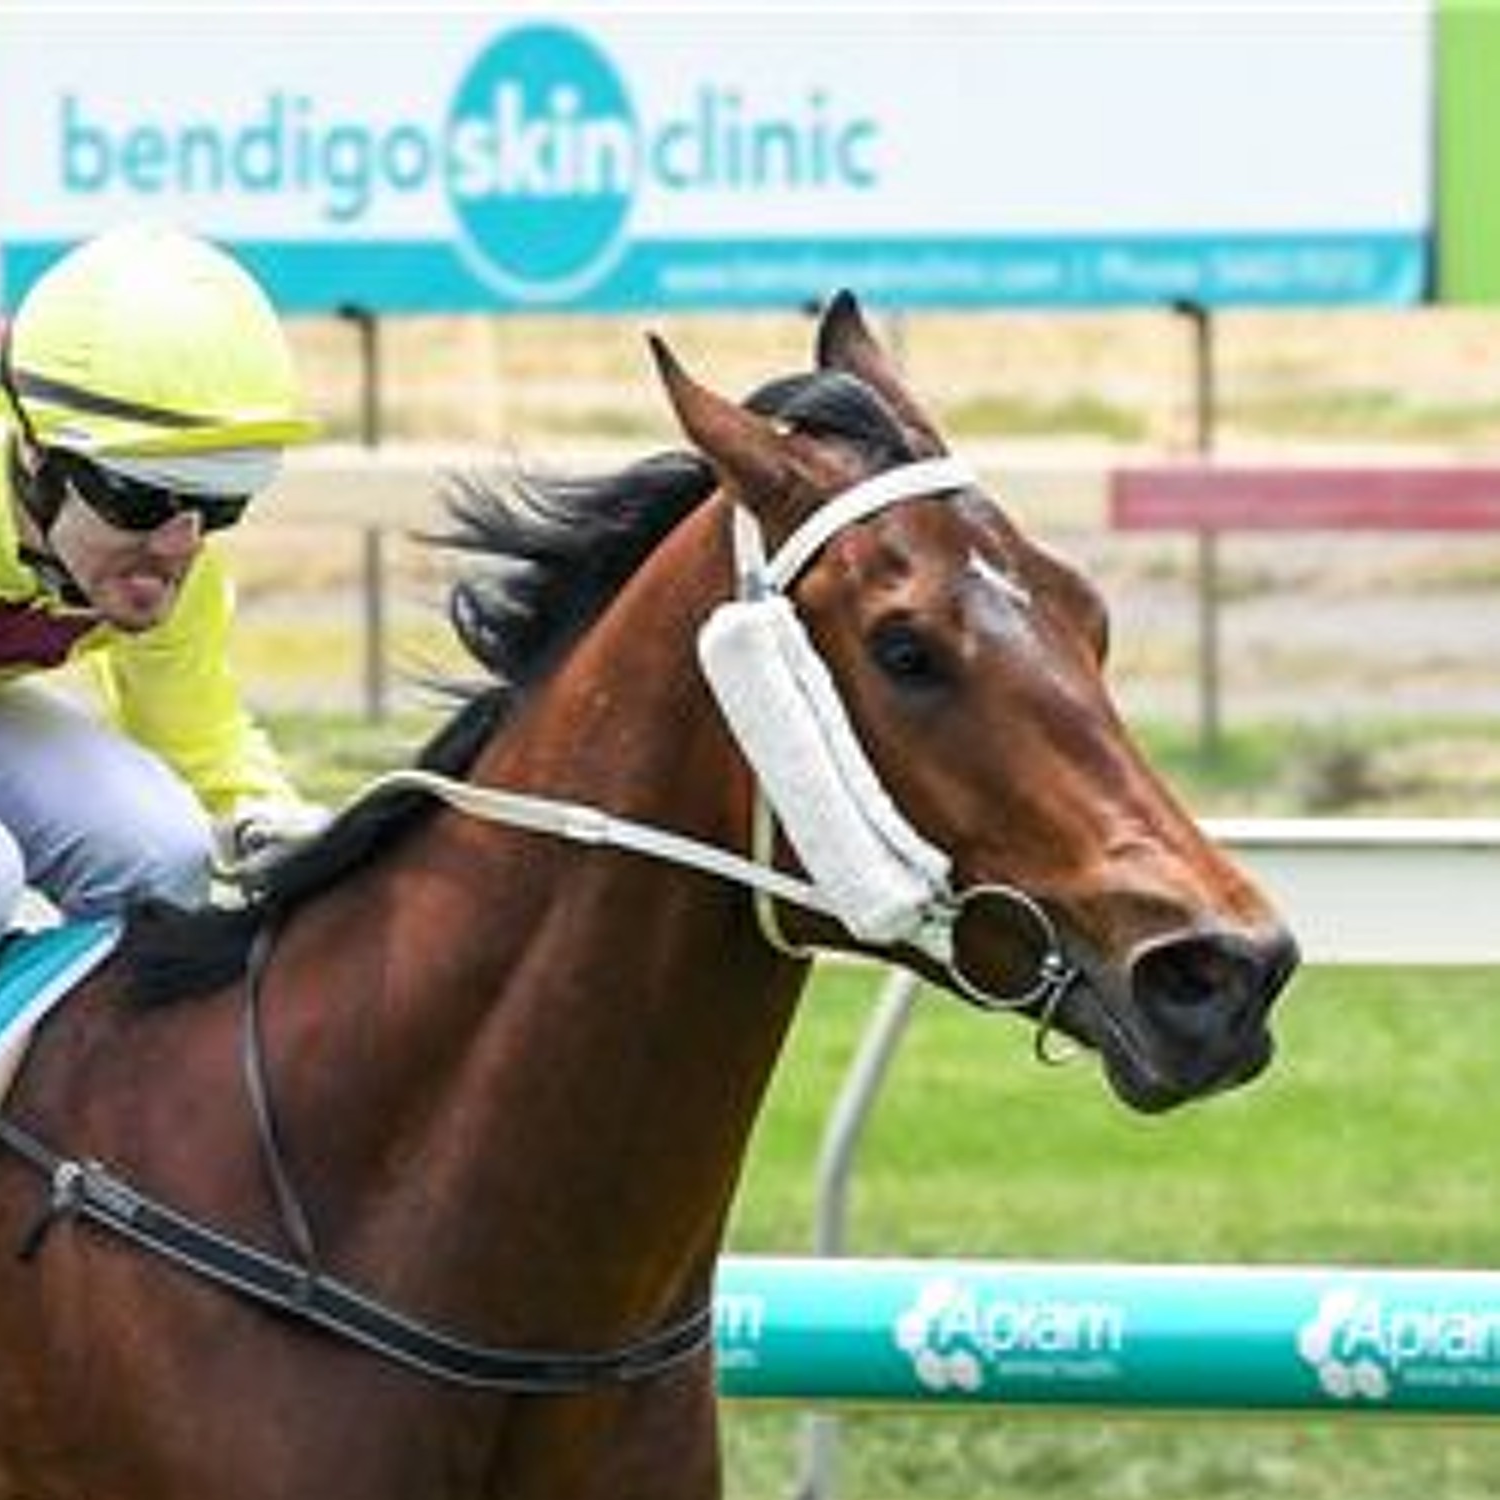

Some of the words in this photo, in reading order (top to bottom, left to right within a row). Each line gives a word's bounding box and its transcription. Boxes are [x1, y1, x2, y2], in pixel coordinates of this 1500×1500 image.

[62, 95, 430, 221] bendigo
[446, 80, 628, 197] skin
[653, 95, 880, 190] clinic
[938, 1286, 1124, 1362] Apiam
